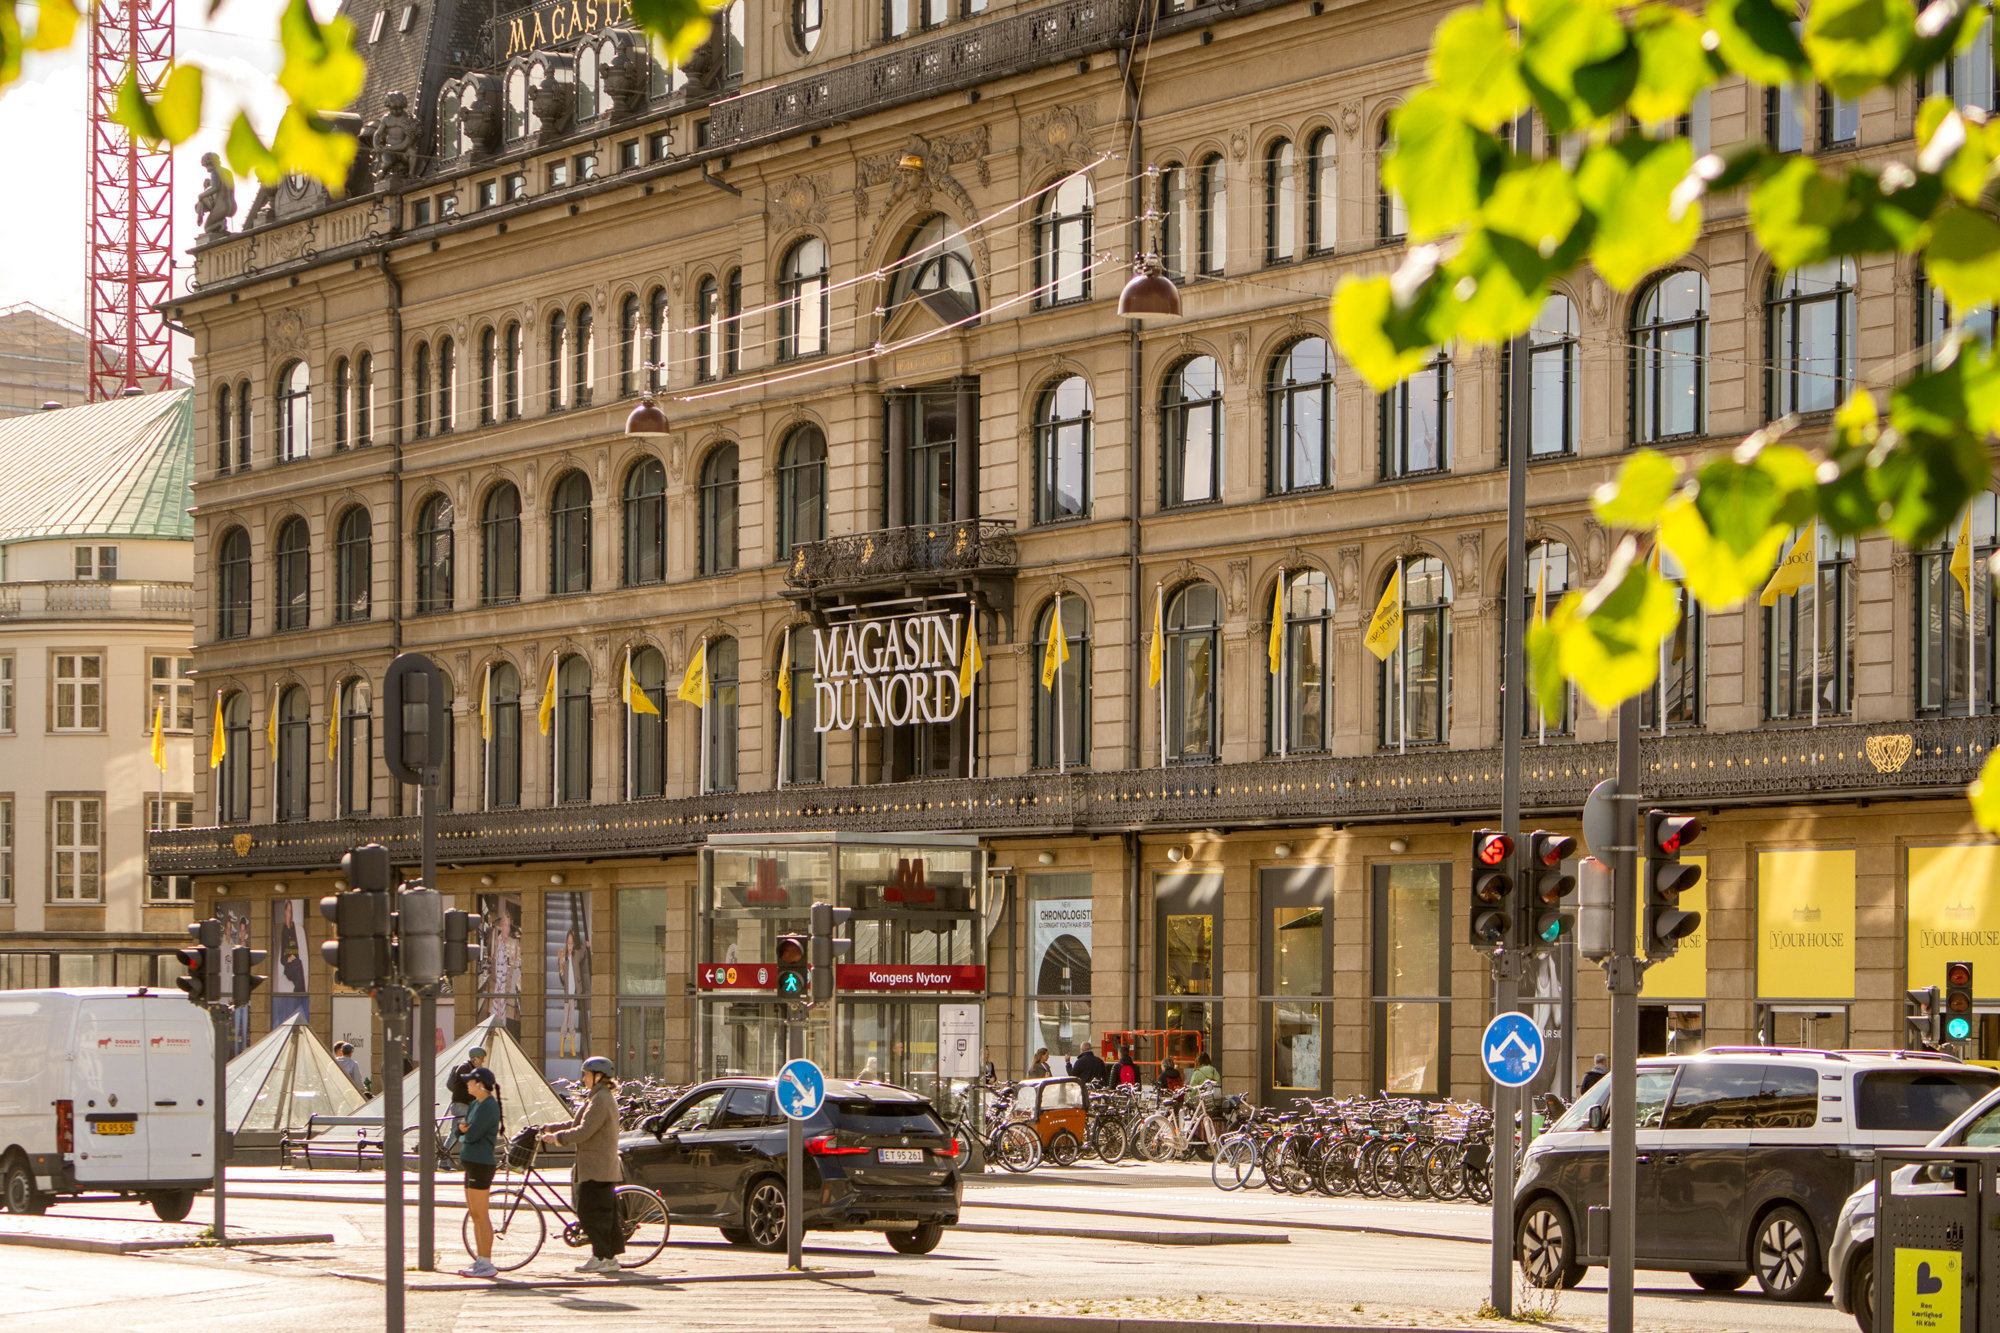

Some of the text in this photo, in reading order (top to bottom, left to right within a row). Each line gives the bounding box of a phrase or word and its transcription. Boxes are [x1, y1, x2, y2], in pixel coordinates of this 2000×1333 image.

[812, 613, 962, 679] MAGASIN
[813, 669, 962, 733] DU NORD
[1040, 909, 1092, 920] CHRONOLOGIST
[1807, 932, 1844, 947] HOUSE
[1961, 931, 2000, 946] HOUSE
[869, 972, 952, 986] Kongens Nytorv
[884, 1151, 922, 1161] ET 95 261
